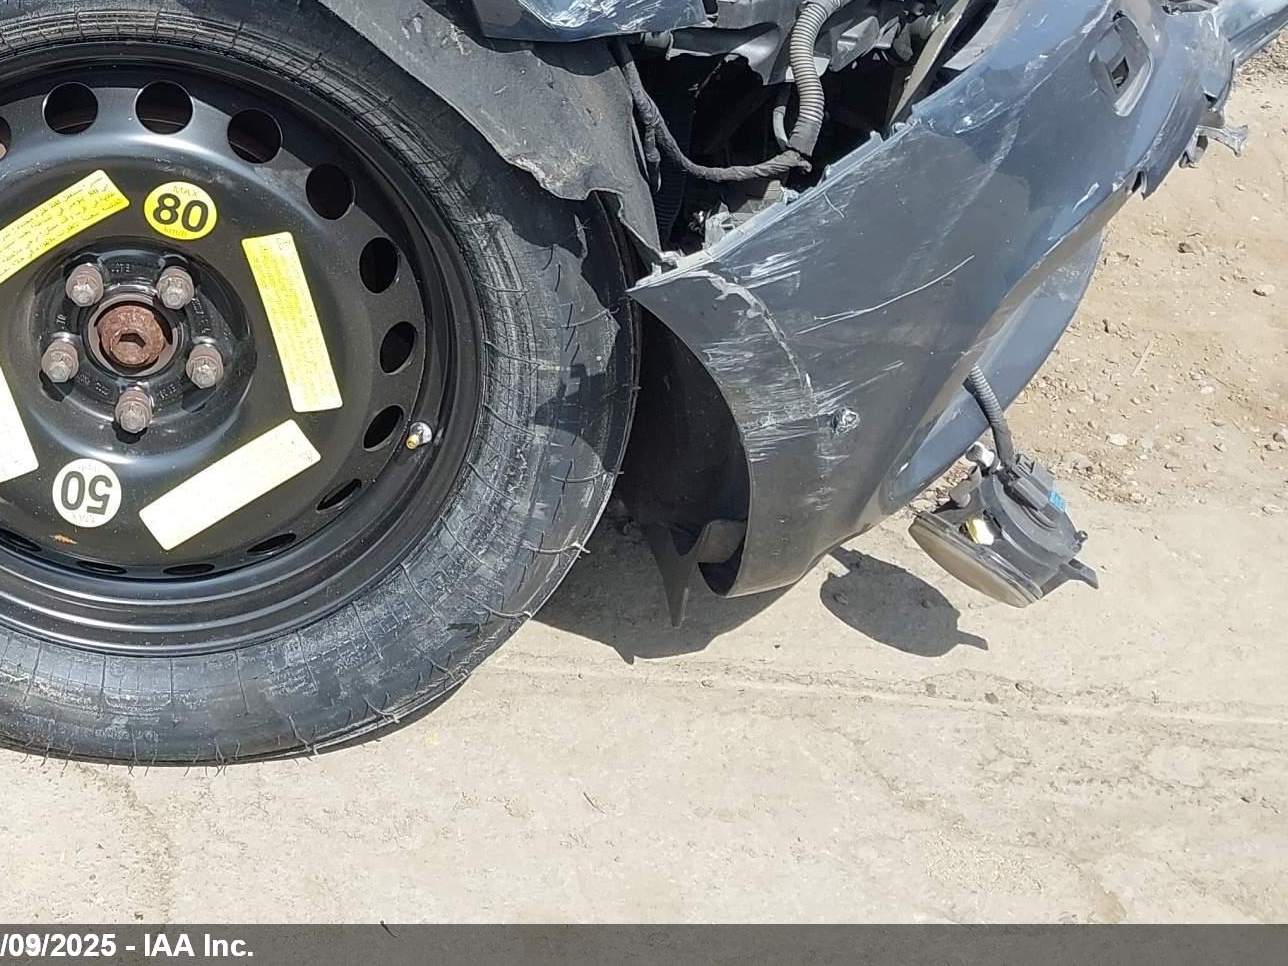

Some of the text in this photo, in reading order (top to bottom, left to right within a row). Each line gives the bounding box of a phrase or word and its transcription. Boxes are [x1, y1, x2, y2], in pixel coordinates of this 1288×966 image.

[173, 186, 199, 199] MAX
[153, 193, 209, 232] 80
[60, 471, 113, 516] 50
